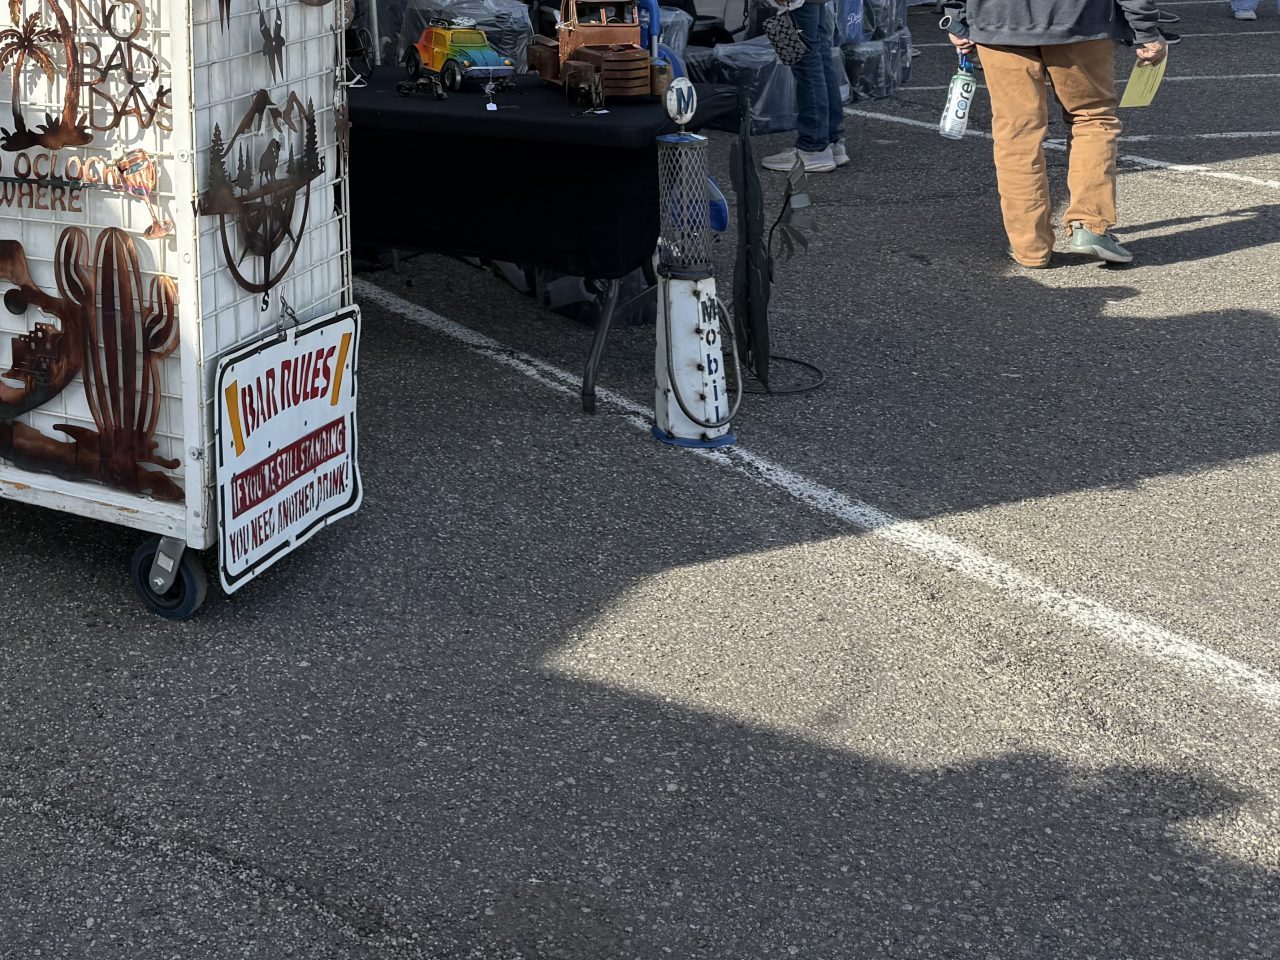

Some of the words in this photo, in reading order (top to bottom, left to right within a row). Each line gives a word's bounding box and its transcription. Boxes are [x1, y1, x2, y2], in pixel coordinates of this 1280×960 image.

[77, 39, 160, 87] BAD
[88, 84, 174, 133] DAYS
[675, 85, 694, 115] M
[955, 82, 973, 120] core
[13, 151, 121, 186] OCLOCK
[261, 290, 270, 312] S
[699, 298, 721, 424] Mobil
[240, 367, 279, 439] BAR
[280, 345, 337, 412] RULES
[232, 477, 243, 514] IF
[242, 461, 277, 507] YOU'RE
[276, 447, 300, 486] STILL
[300, 422, 344, 472] STANDING
[229, 523, 251, 564] YOU
[250, 507, 276, 551] NEED
[277, 480, 315, 535] ANOTHER
[315, 460, 350, 512] DRINK!
